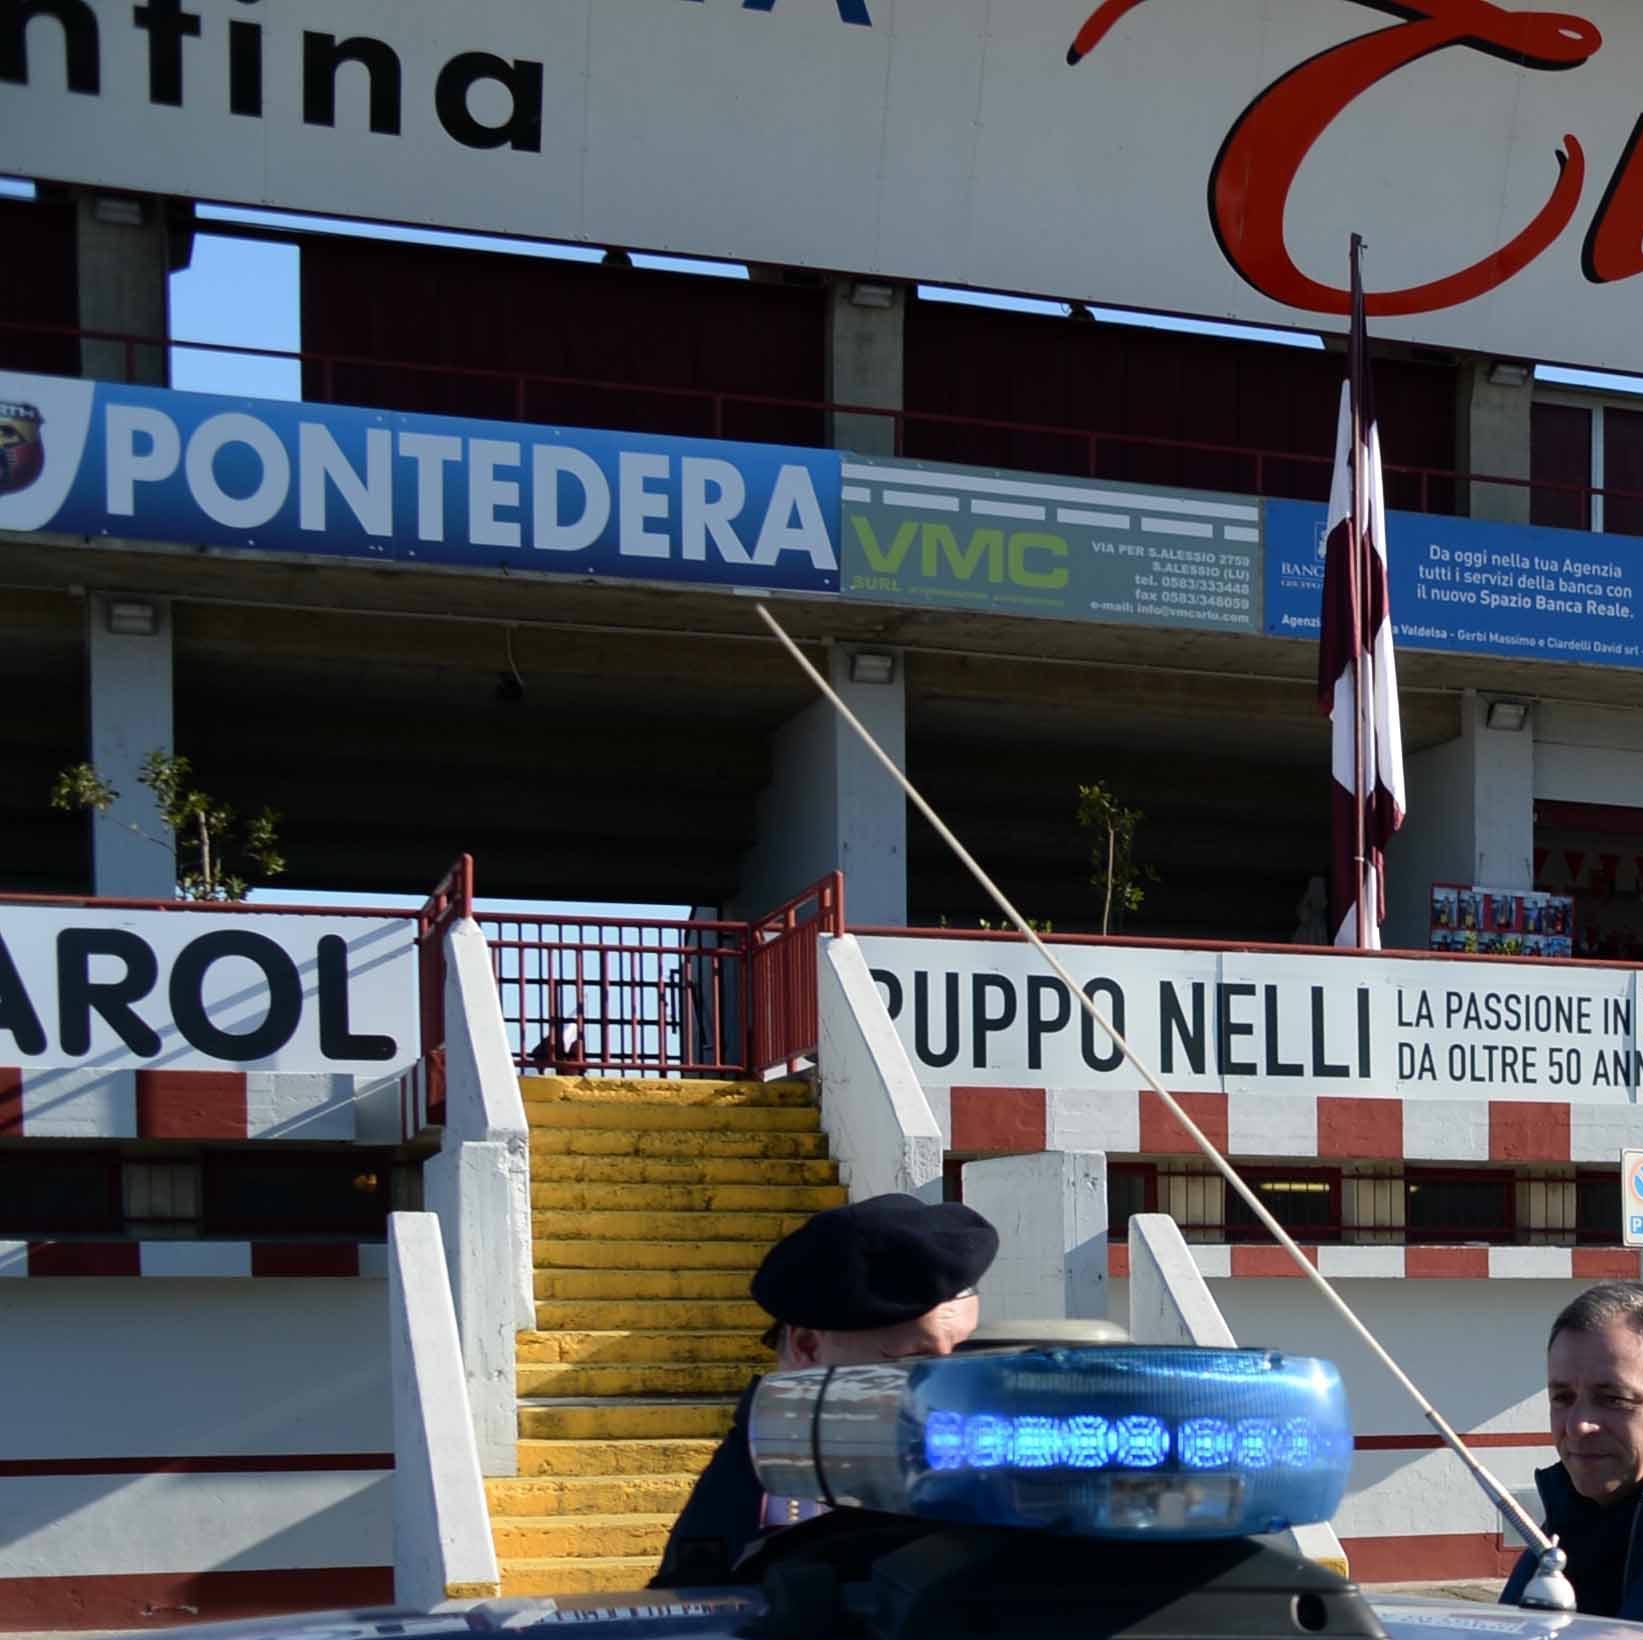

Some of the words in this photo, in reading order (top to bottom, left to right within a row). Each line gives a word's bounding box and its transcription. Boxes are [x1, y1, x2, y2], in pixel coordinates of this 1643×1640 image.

[105, 403, 839, 571] PONTEDERA
[851, 515, 1069, 590] VMC
[1091, 540, 1114, 553] VIA
[1119, 543, 1144, 557] PER
[1429, 544, 1450, 561] Da
[1454, 549, 1487, 568] oggi
[1492, 551, 1530, 569] nella
[1534, 556, 1558, 572] tua
[1563, 559, 1622, 579] Agenzia
[1417, 583, 1426, 599] il
[1431, 587, 1476, 604] nuovo
[1480, 590, 1531, 609] Spazio
[1535, 595, 1582, 614] Banca
[1586, 600, 1634, 619] Reale.
[1418, 564, 1450, 580] tutti
[1464, 569, 1513, 587] servizi
[1518, 573, 1555, 592] della
[1559, 577, 1602, 596] banca
[1606, 584, 1632, 598] con
[1281, 613, 1321, 628] Agenzi
[1159, 980, 1372, 1079] NELLI
[1398, 989, 1434, 1029] LA
[1446, 991, 1593, 1035] PASSIONE
[1604, 997, 1632, 1037] IN
[1398, 1041, 1438, 1081] DA
[1448, 1044, 1537, 1084] OLTRE
[1548, 1047, 1582, 1085] 50
